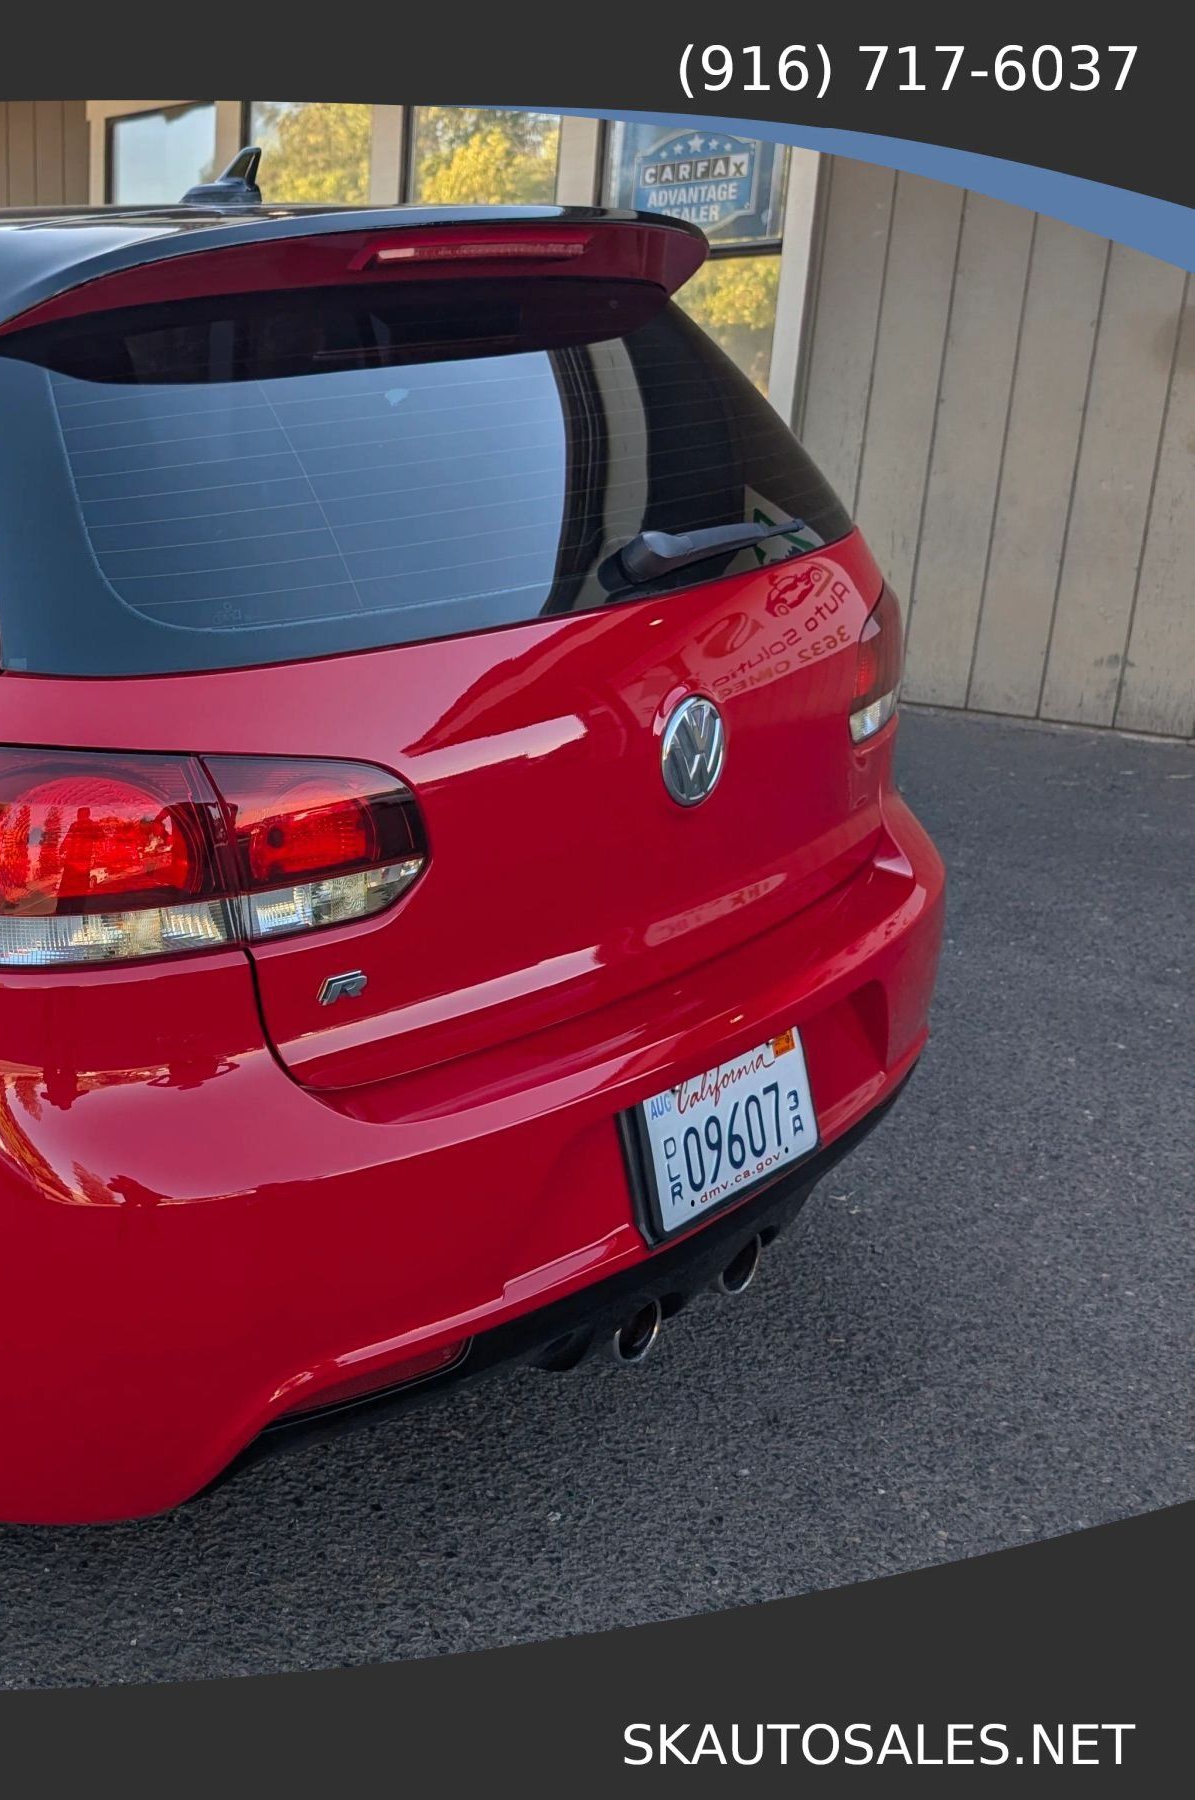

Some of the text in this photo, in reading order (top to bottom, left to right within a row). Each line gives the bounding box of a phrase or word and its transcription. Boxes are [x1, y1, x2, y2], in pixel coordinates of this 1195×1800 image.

[643, 160, 745, 185] CARFAX
[647, 182, 737, 208] ADVANTAGE
[676, 1050, 776, 1115] California
[650, 1094, 672, 1121] AUG
[682, 1081, 783, 1193] 09607
[700, 1151, 781, 1205] dmv.ca.gov
